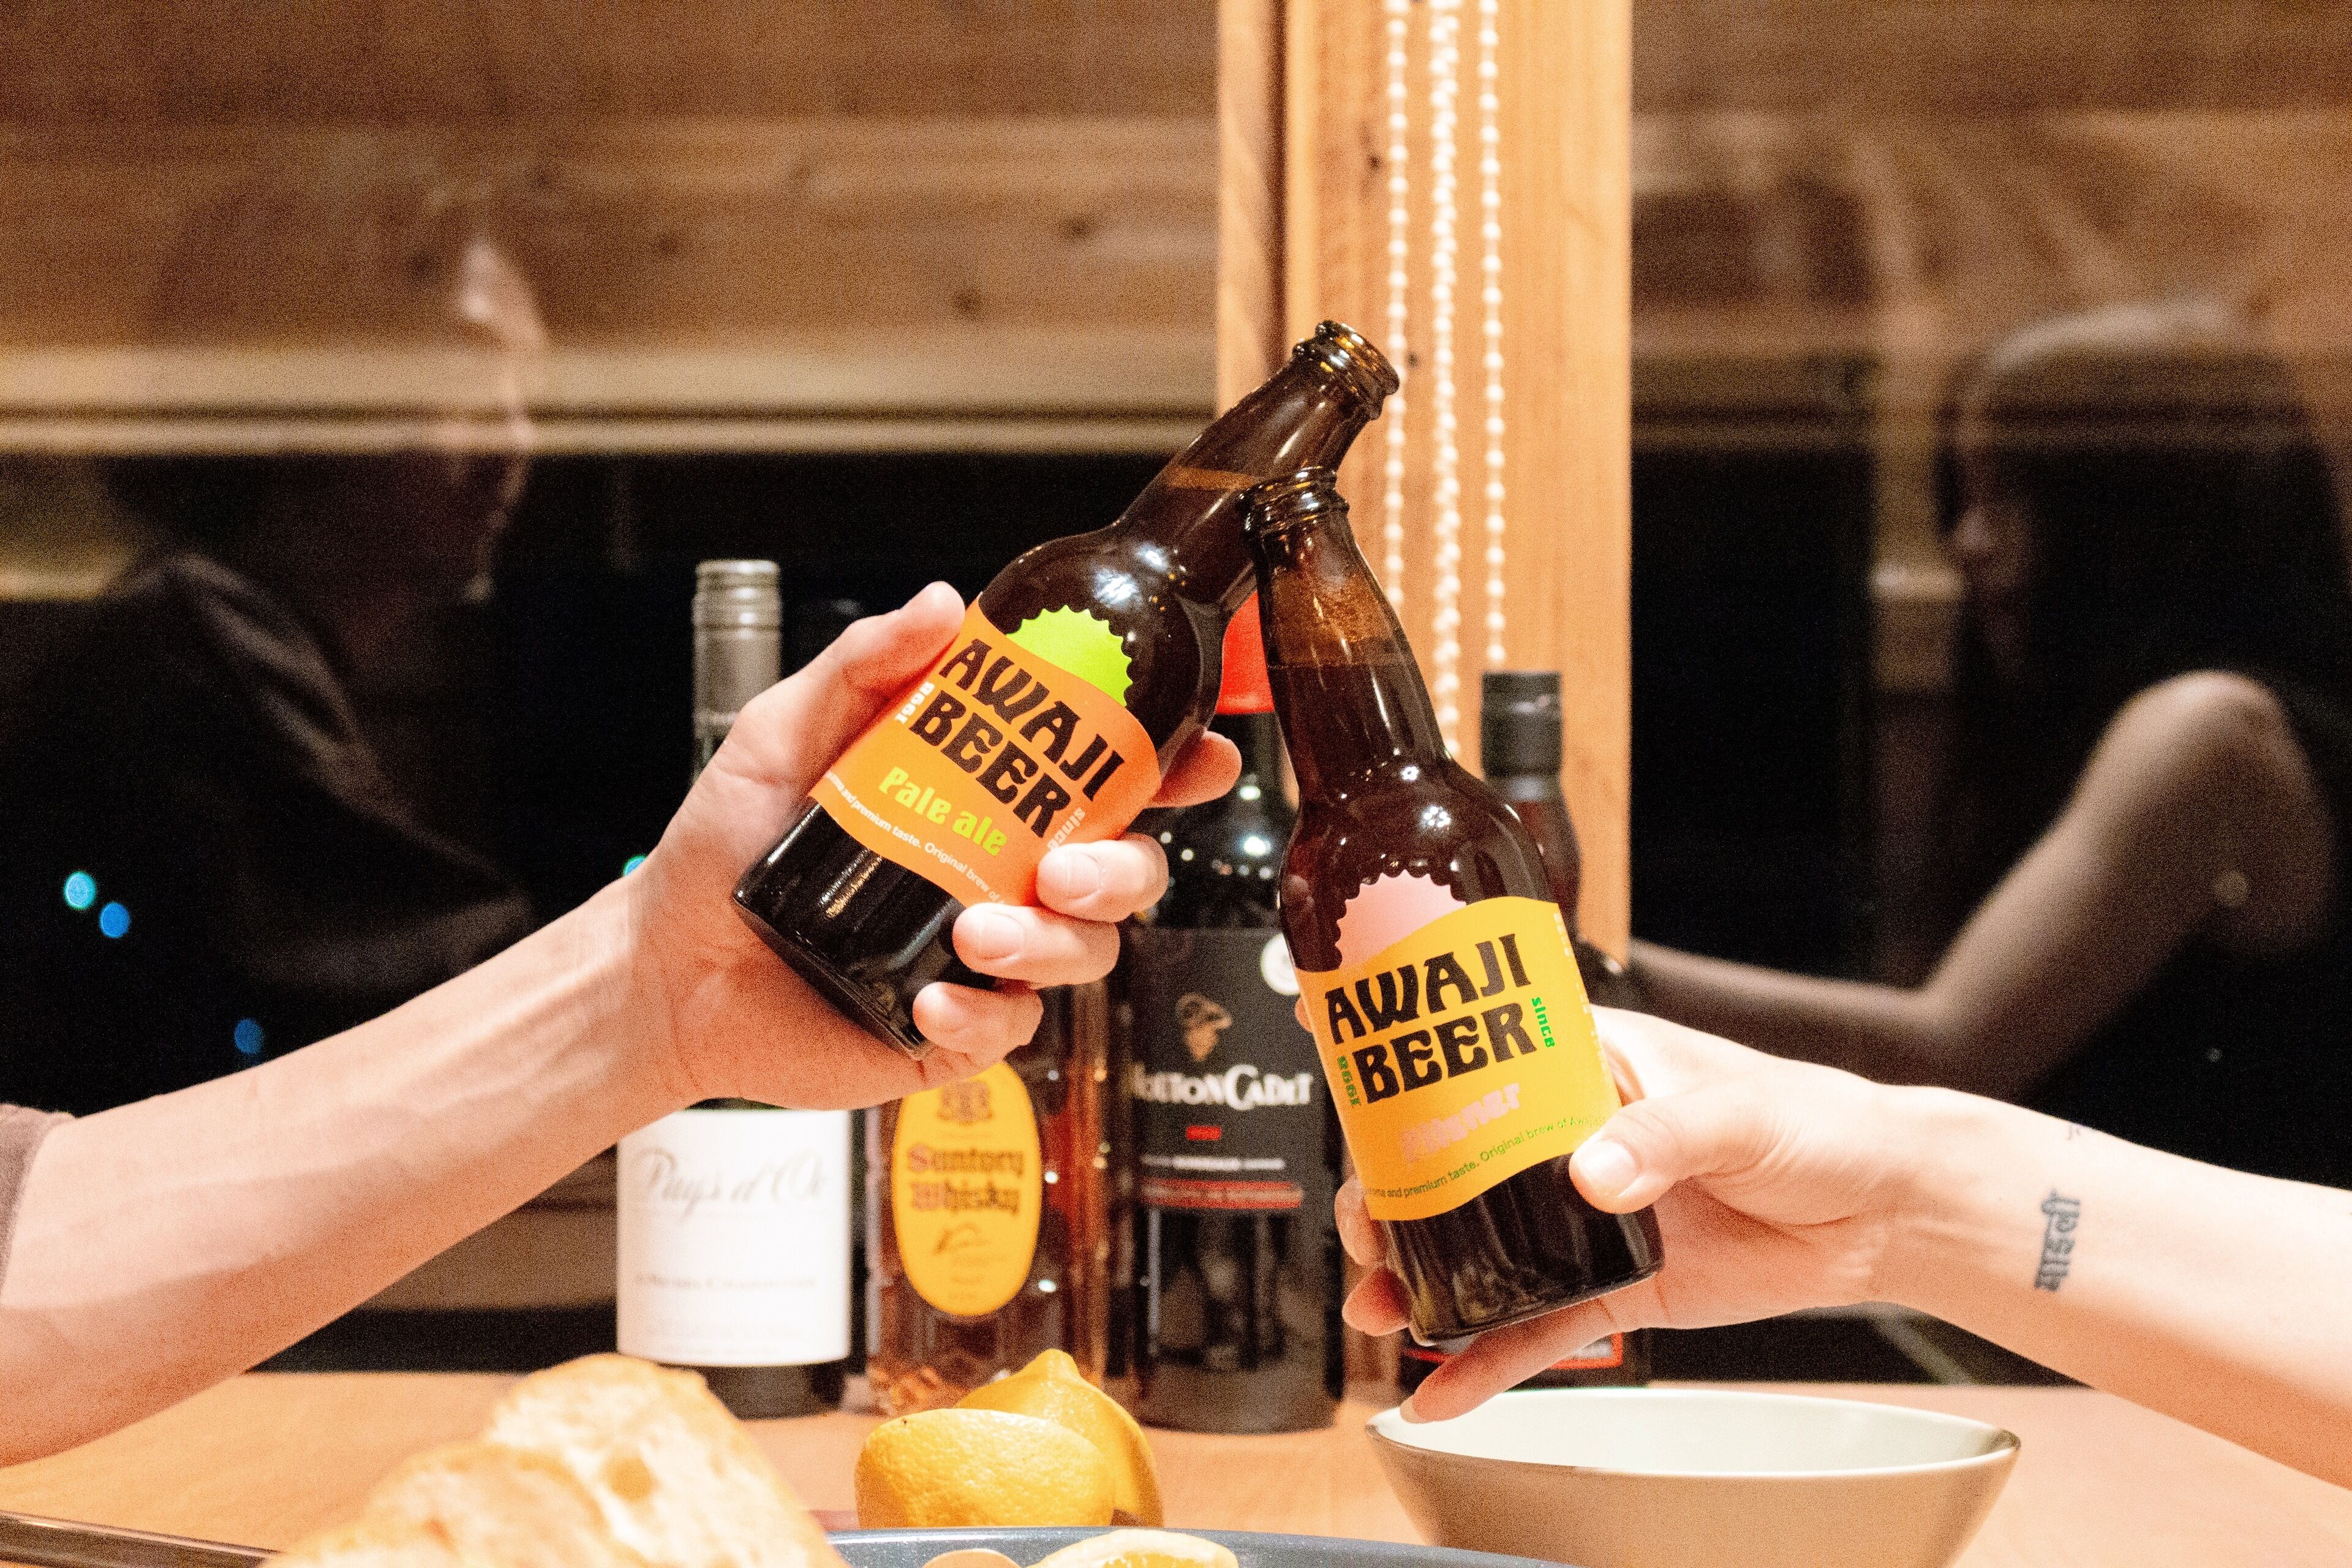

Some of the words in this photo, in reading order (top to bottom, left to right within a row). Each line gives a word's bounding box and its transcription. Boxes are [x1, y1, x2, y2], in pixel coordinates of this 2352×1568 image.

[909, 690, 1071, 838] BEER
[938, 638, 1125, 802] AWAJI
[850, 799, 892, 832] premium
[892, 826, 921, 848] taste.
[924, 842, 968, 873] Original
[966, 868, 990, 892] brew
[879, 766, 952, 824] Pale
[952, 810, 1008, 856] ale
[1324, 933, 1532, 1044] AWAJI
[1531, 997, 1555, 1049] since
[1352, 1003, 1537, 1104] BEER
[1400, 1082, 1520, 1163] Pilsner
[1404, 1176, 1448, 1198] premium
[1447, 1161, 1479, 1180] taste.
[1480, 1133, 1524, 1161] Original
[1526, 1123, 1554, 1140] brew
[1558, 1118, 1567, 1128] of
